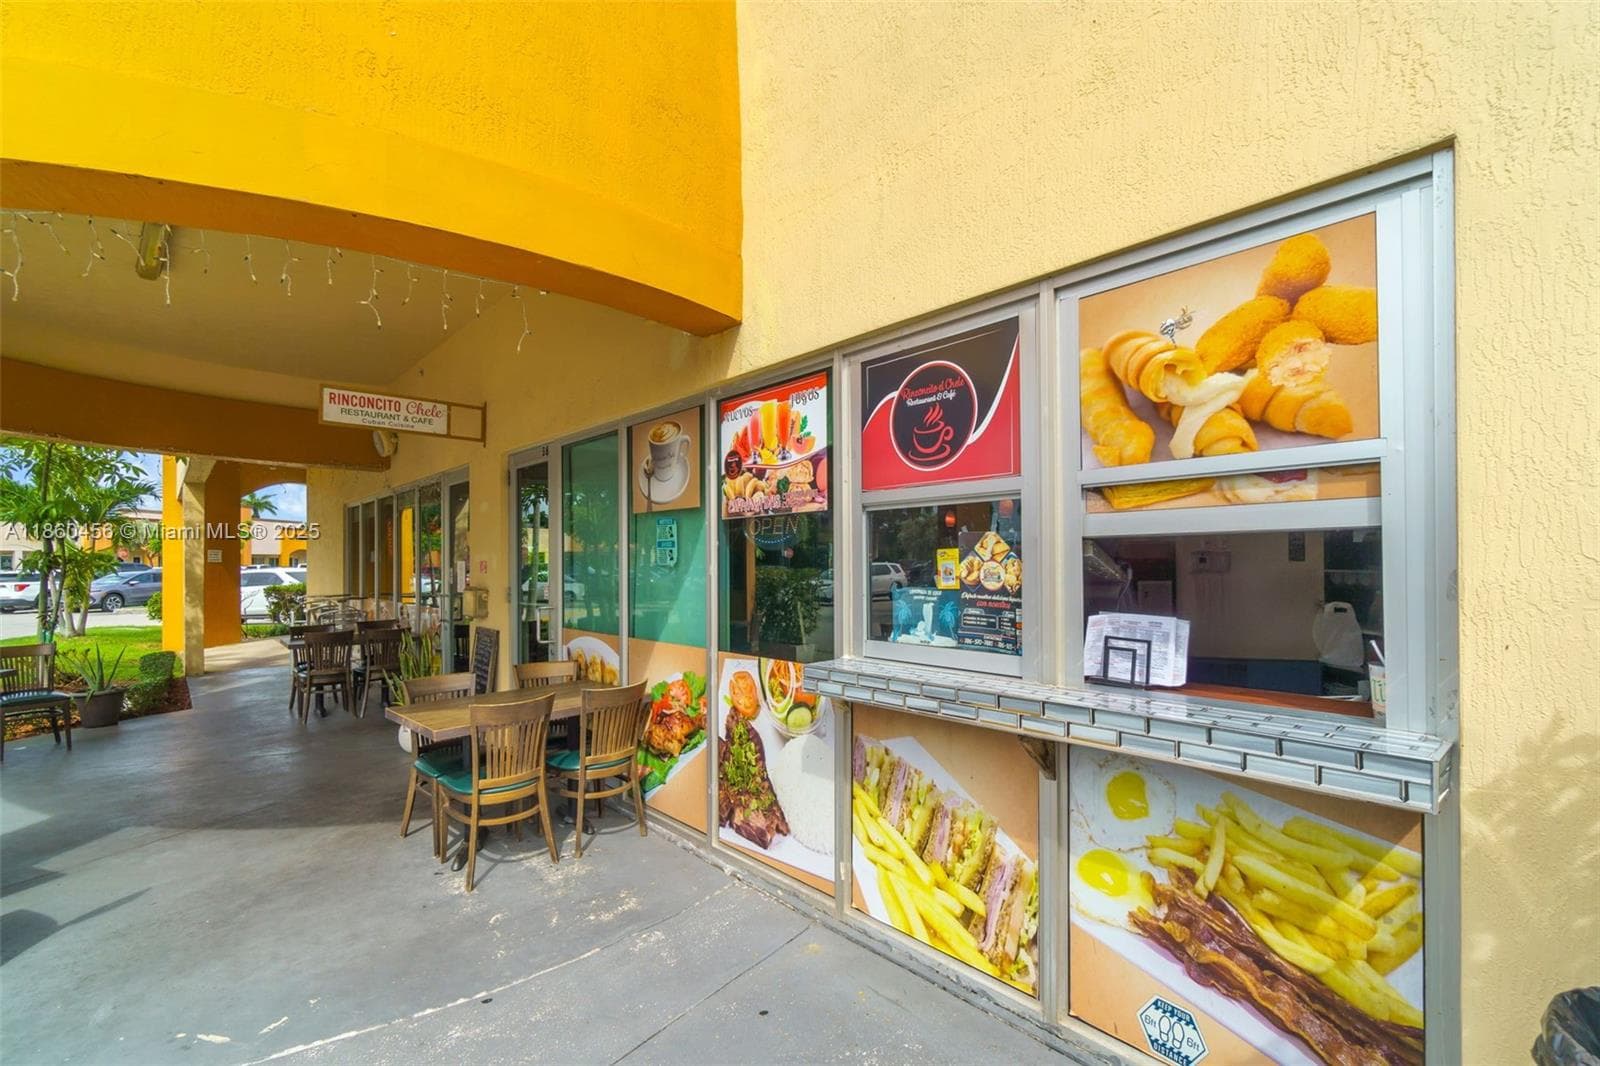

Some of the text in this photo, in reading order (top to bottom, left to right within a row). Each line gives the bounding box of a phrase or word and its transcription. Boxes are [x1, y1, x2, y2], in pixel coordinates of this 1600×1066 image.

[937, 393, 942, 401] &
[329, 392, 443, 418] RINCONCITO Chele
[340, 408, 401, 421] RESTAURANT
[362, 418, 415, 429] Cuban Cuisine
[749, 515, 800, 536] OPEN
[1158, 1001, 1190, 1021] KEEP YOUR
[1144, 1015, 1156, 1028] 6ft
[1187, 1037, 1200, 1052] 6ft
